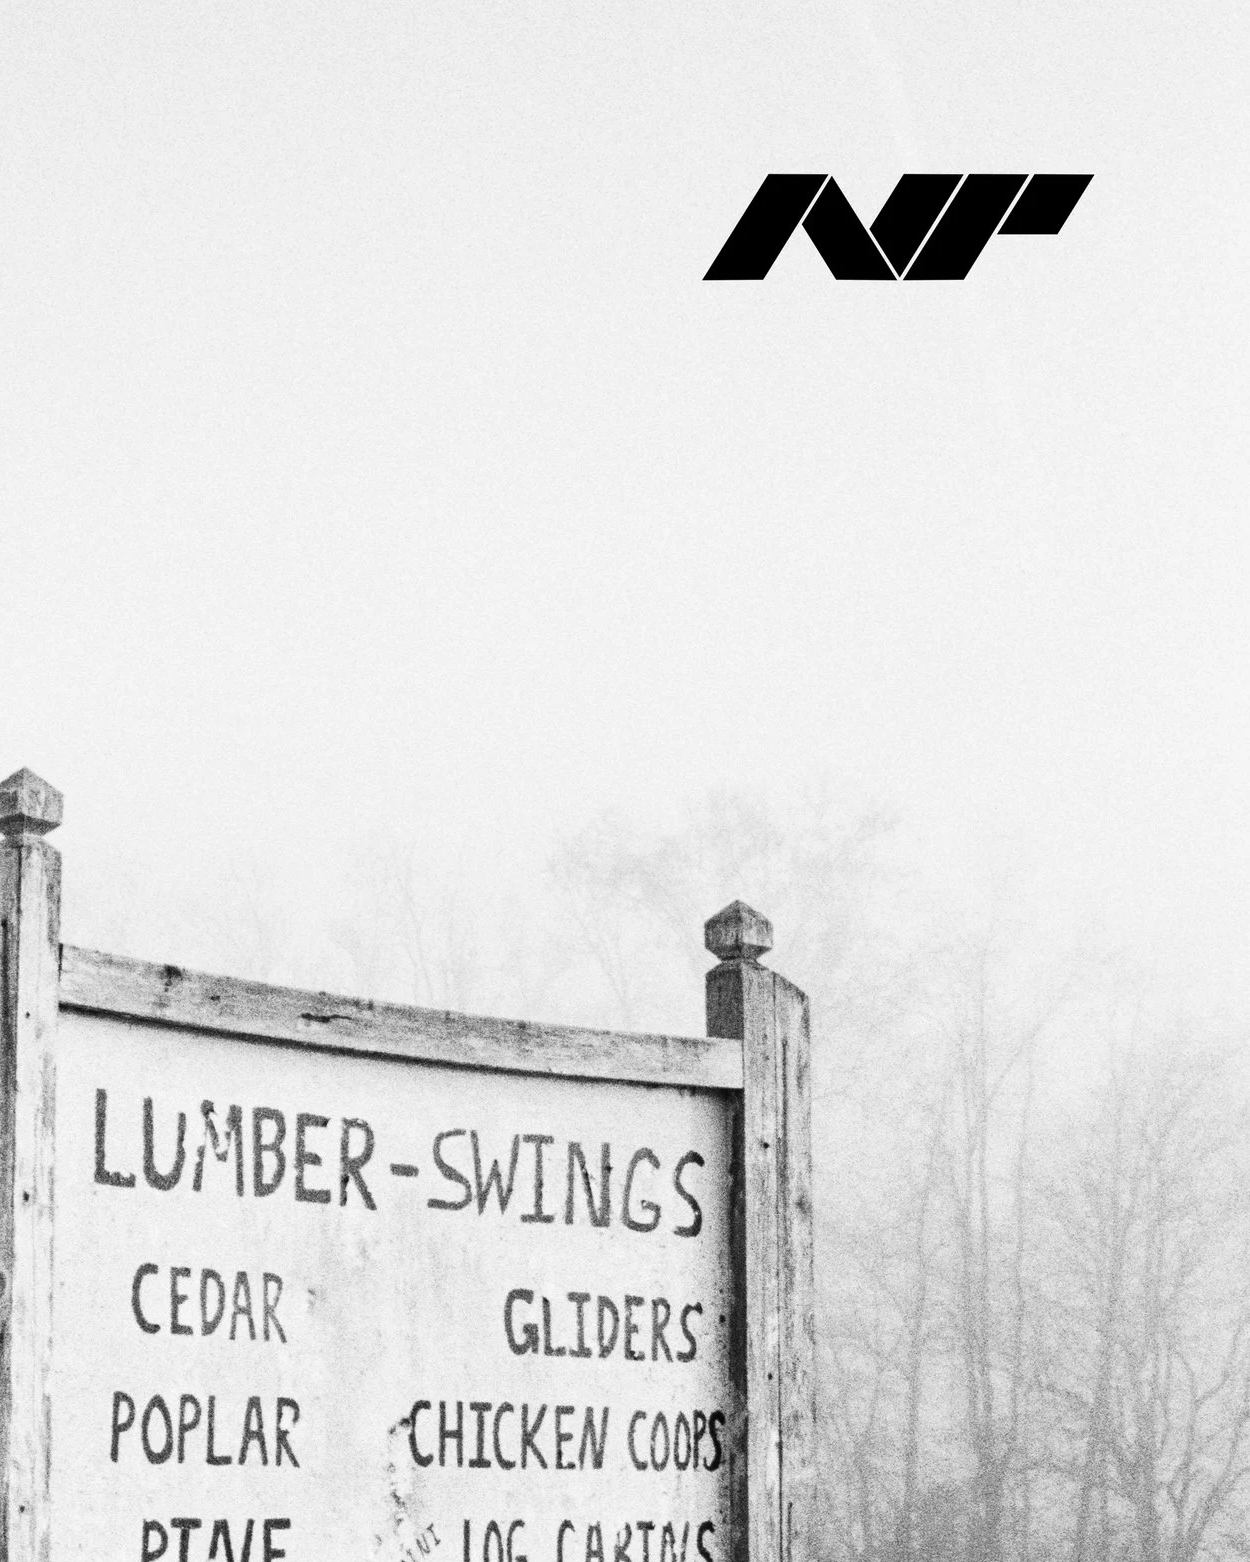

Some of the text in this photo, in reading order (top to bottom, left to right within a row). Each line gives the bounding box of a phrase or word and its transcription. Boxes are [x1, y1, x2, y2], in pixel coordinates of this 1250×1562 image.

[131, 1262, 287, 1343] CEDAR
[504, 1288, 703, 1362] GLIDERS
[110, 1391, 301, 1468] POPLAR
[408, 1400, 726, 1472] CHICKEN COOPS
